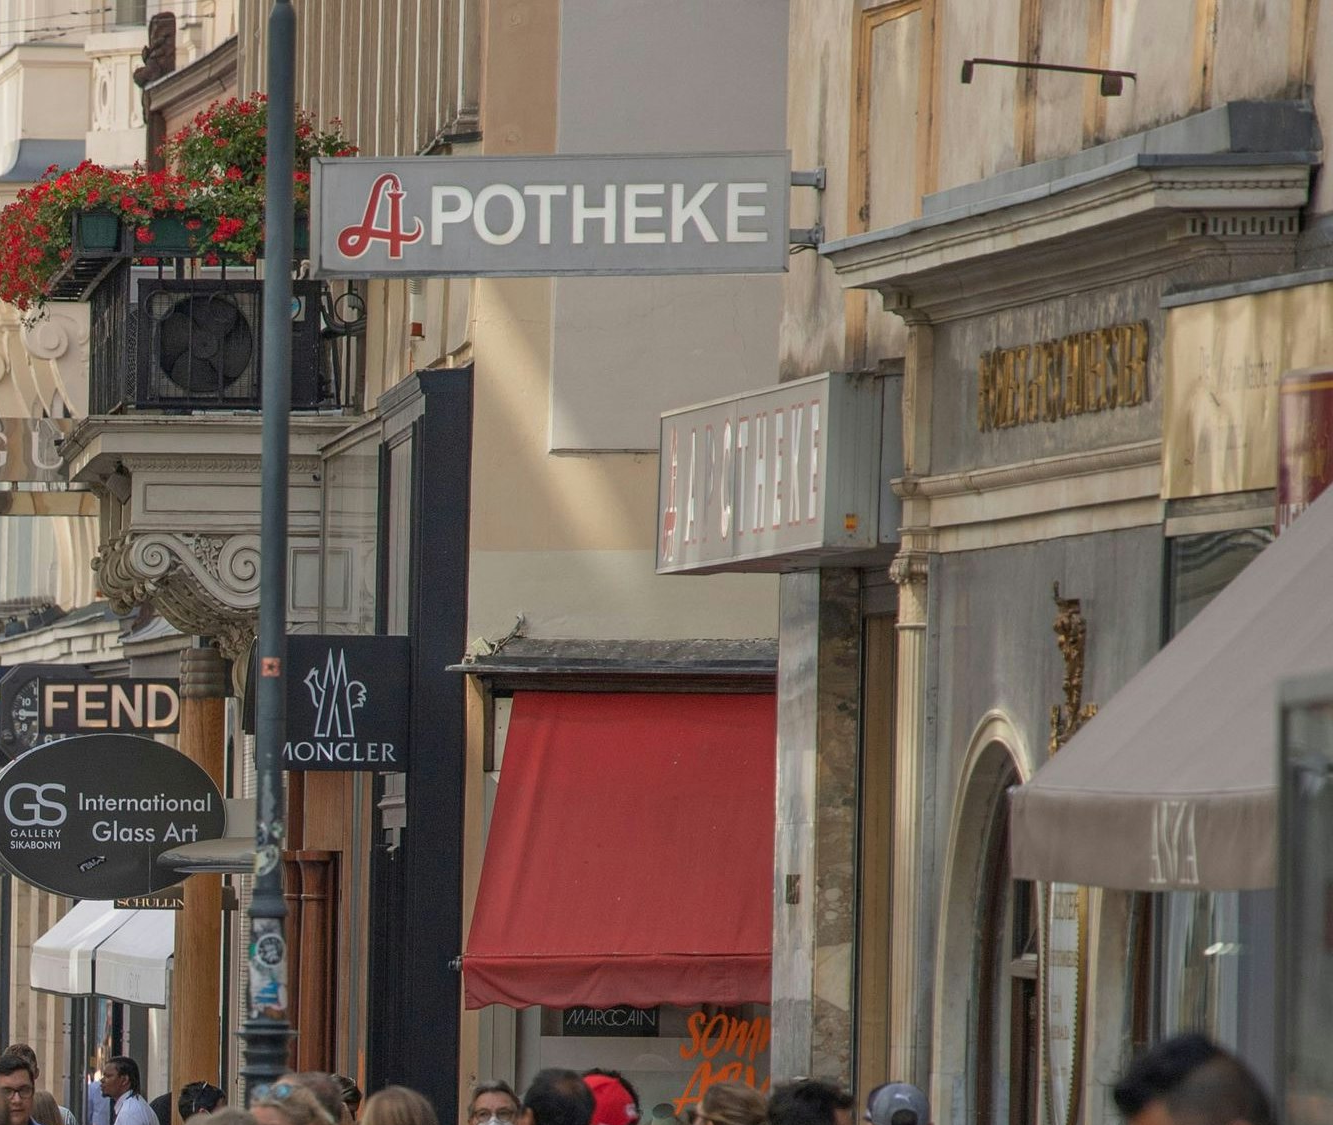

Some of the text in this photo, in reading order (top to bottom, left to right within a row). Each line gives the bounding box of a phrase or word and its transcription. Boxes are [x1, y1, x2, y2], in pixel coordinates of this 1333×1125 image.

[3, 782, 212, 827] GS International
[10, 828, 62, 838] GALLERY
[91, 820, 199, 843] Glass Art
[9, 840, 62, 850] SIKABONYI
